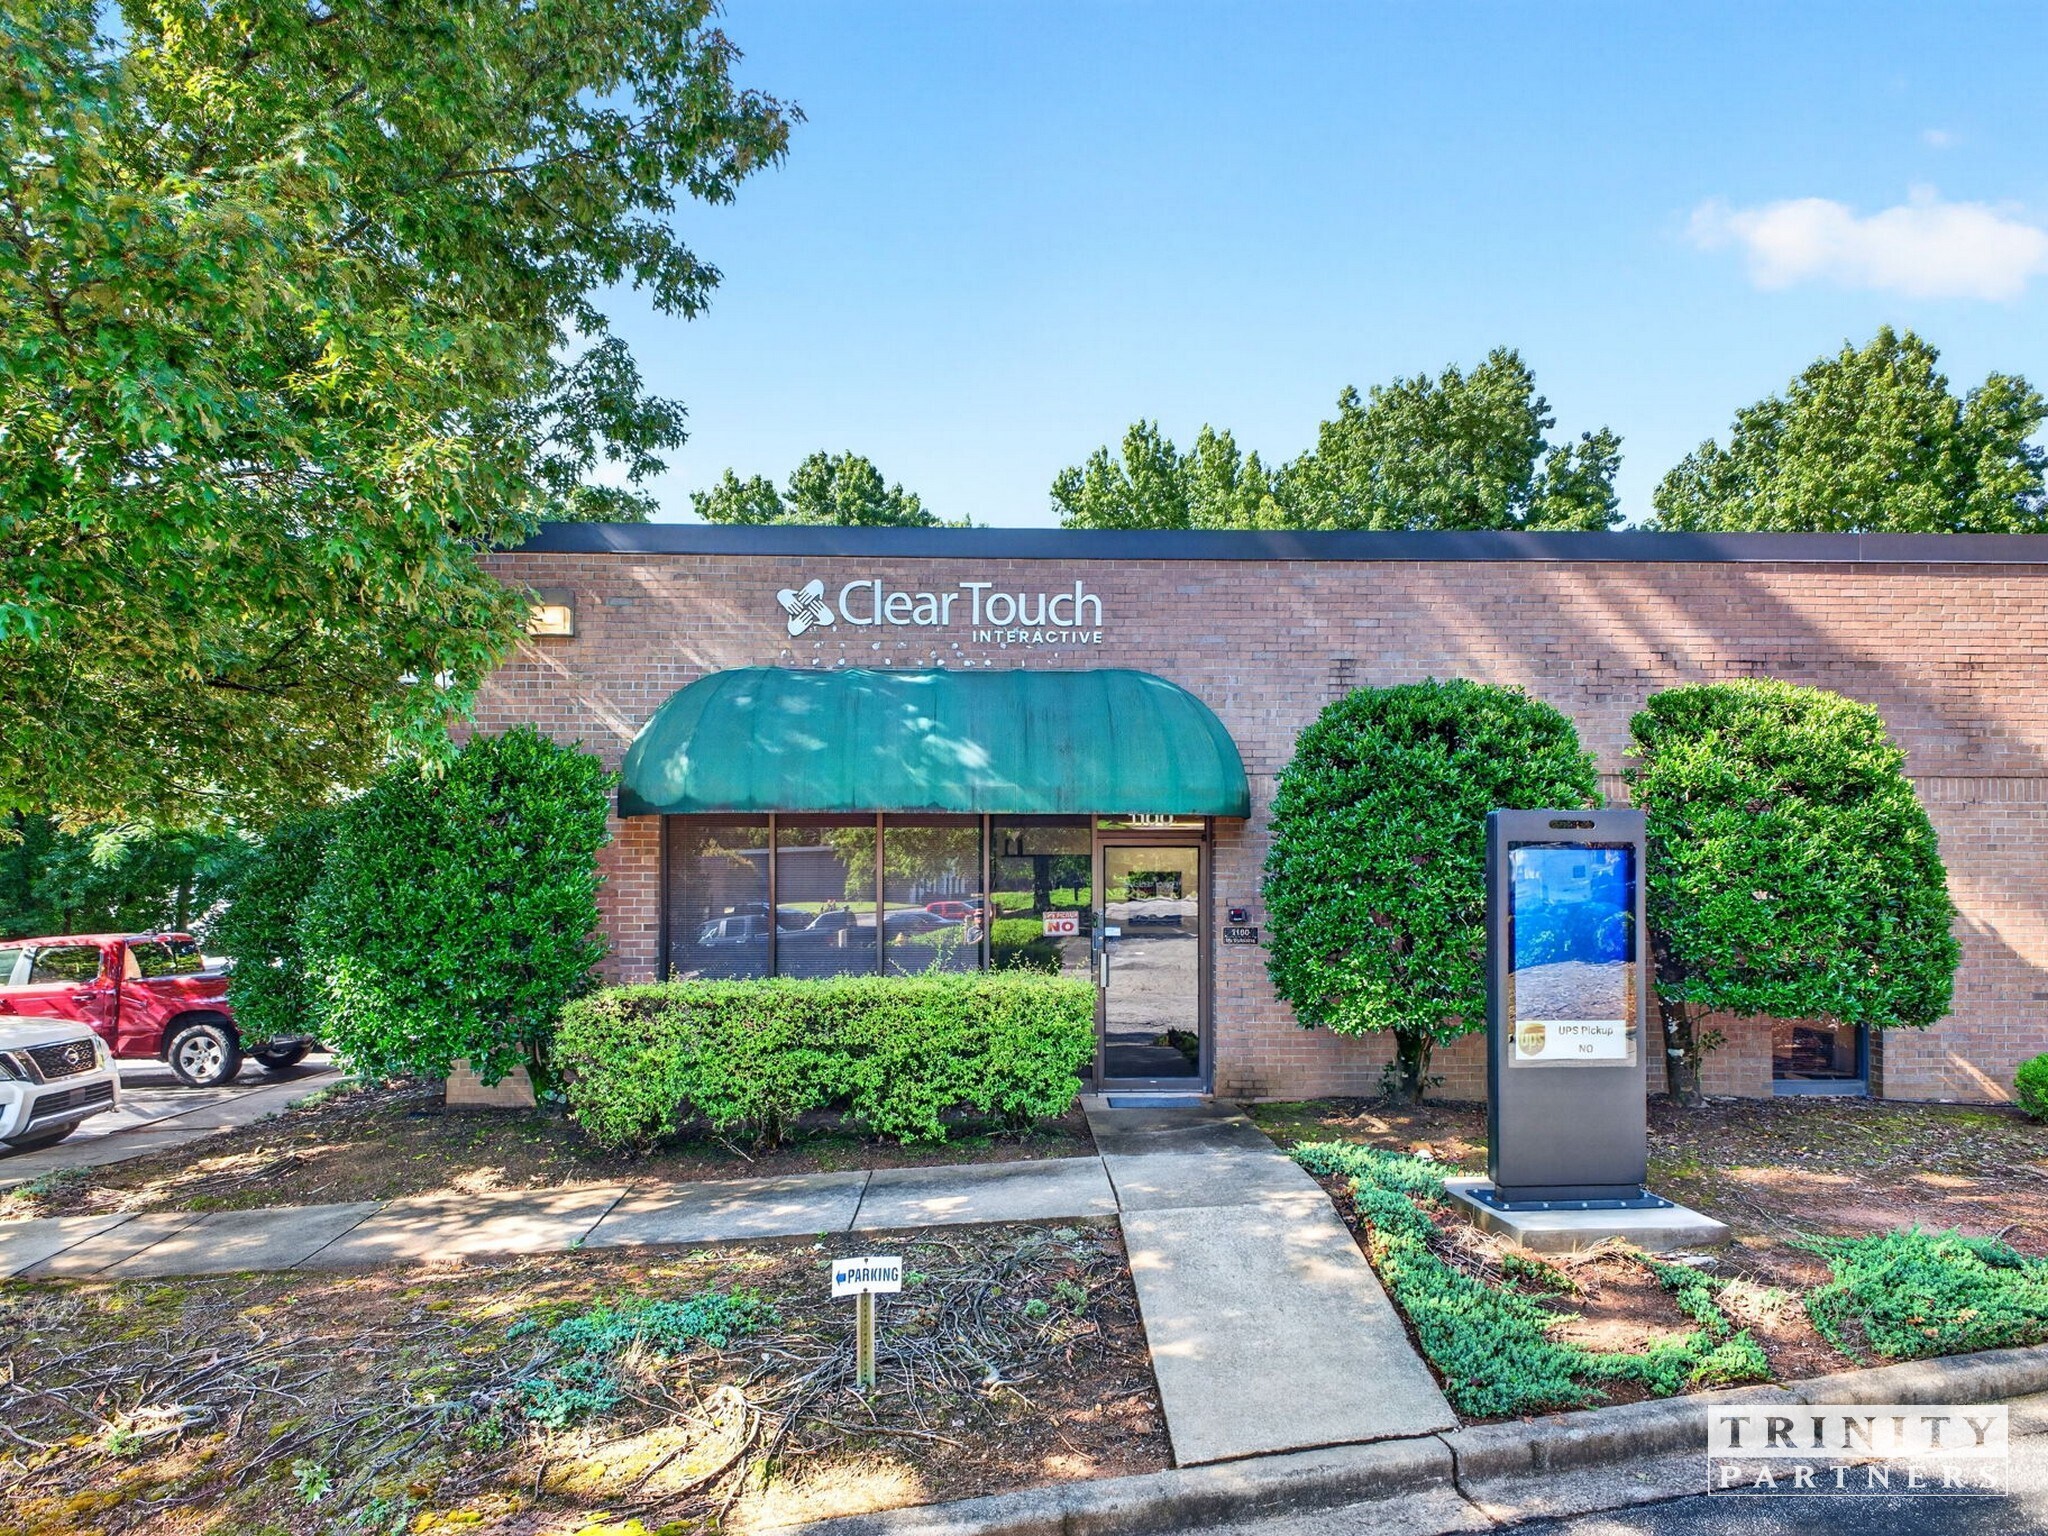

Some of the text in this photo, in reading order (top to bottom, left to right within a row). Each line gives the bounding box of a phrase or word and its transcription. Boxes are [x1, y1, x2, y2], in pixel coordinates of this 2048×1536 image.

[972, 630, 1104, 644] INTERACTIVE
[1047, 921, 1074, 932] NO
[1558, 1025, 1614, 1036] UPS Pickup
[1578, 1044, 1594, 1053] NO
[847, 1266, 899, 1284] PARKING
